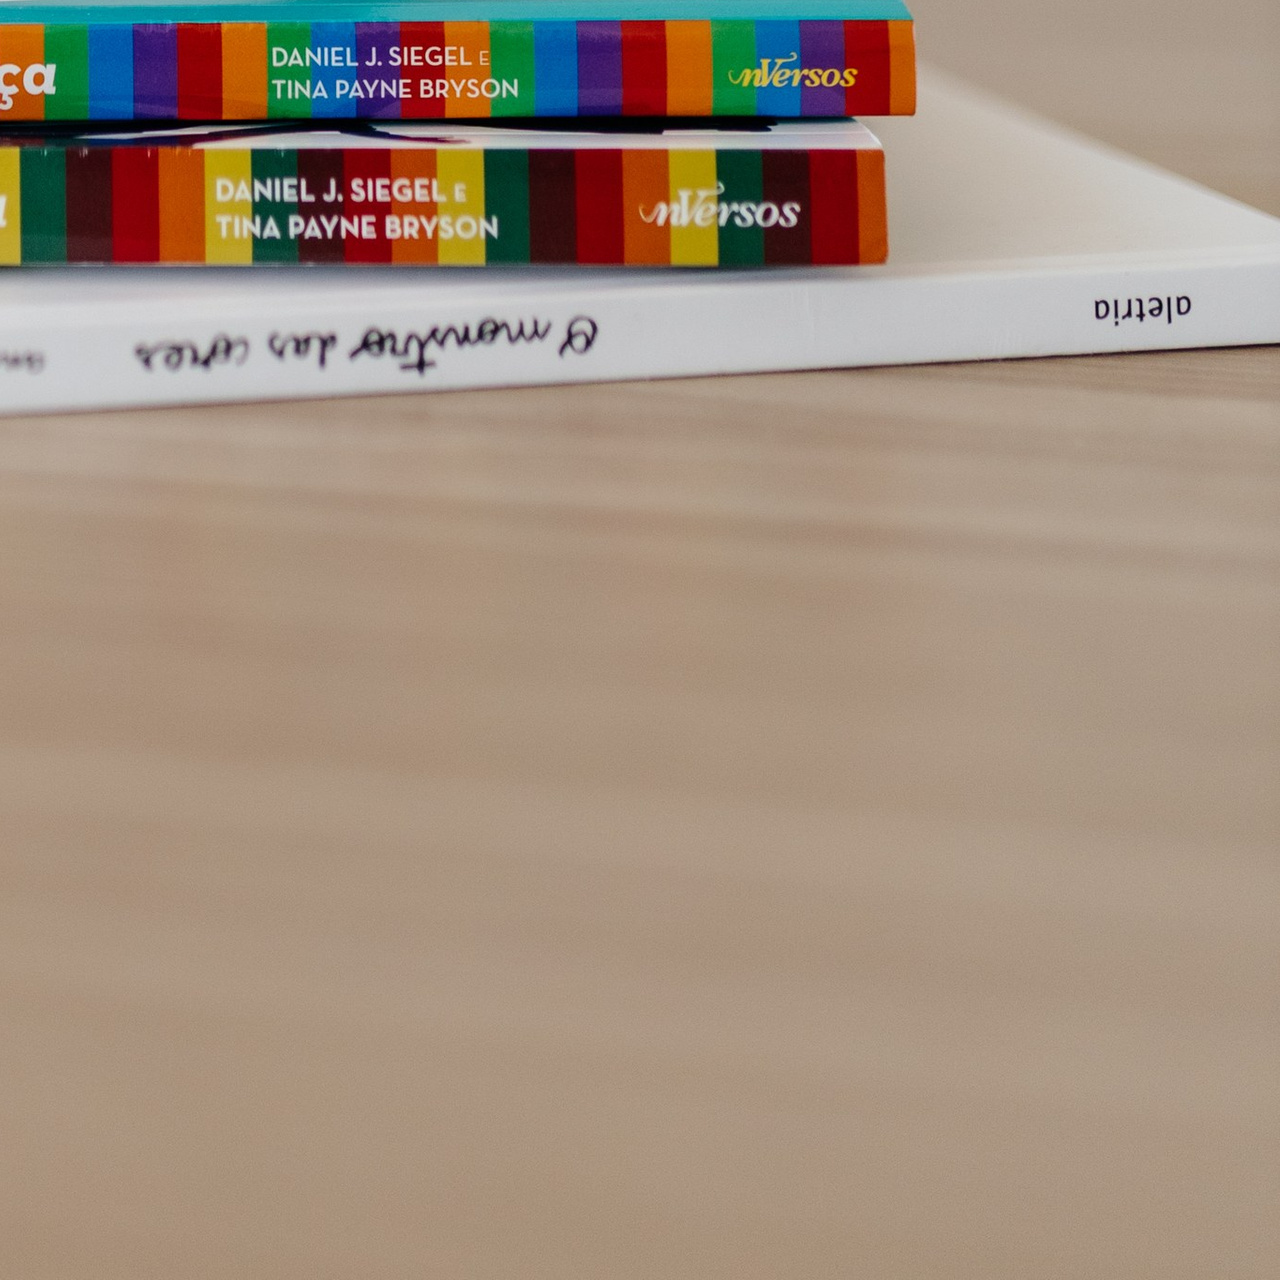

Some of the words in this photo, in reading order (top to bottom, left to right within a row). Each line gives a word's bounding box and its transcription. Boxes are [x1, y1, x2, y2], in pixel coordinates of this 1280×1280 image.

[271, 45, 359, 68] DANIEL
[365, 46, 383, 68] J.
[388, 45, 473, 67] SIEGEL
[479, 50, 490, 66] E
[271, 78, 329, 100] TINA
[335, 78, 412, 100] PAYNE
[419, 77, 519, 99] BRYSON
[215, 176, 316, 203] DANIEL
[323, 177, 344, 203] J.
[350, 177, 447, 203] SIEGEL
[454, 182, 467, 203] E
[215, 214, 282, 239] TINA
[288, 214, 377, 240] PAYNE
[385, 214, 499, 240] BRYSON
[1094, 295, 1192, 327] aletria
[133, 331, 251, 373] cores
[268, 330, 339, 370] das
[349, 314, 553, 376] monstro
